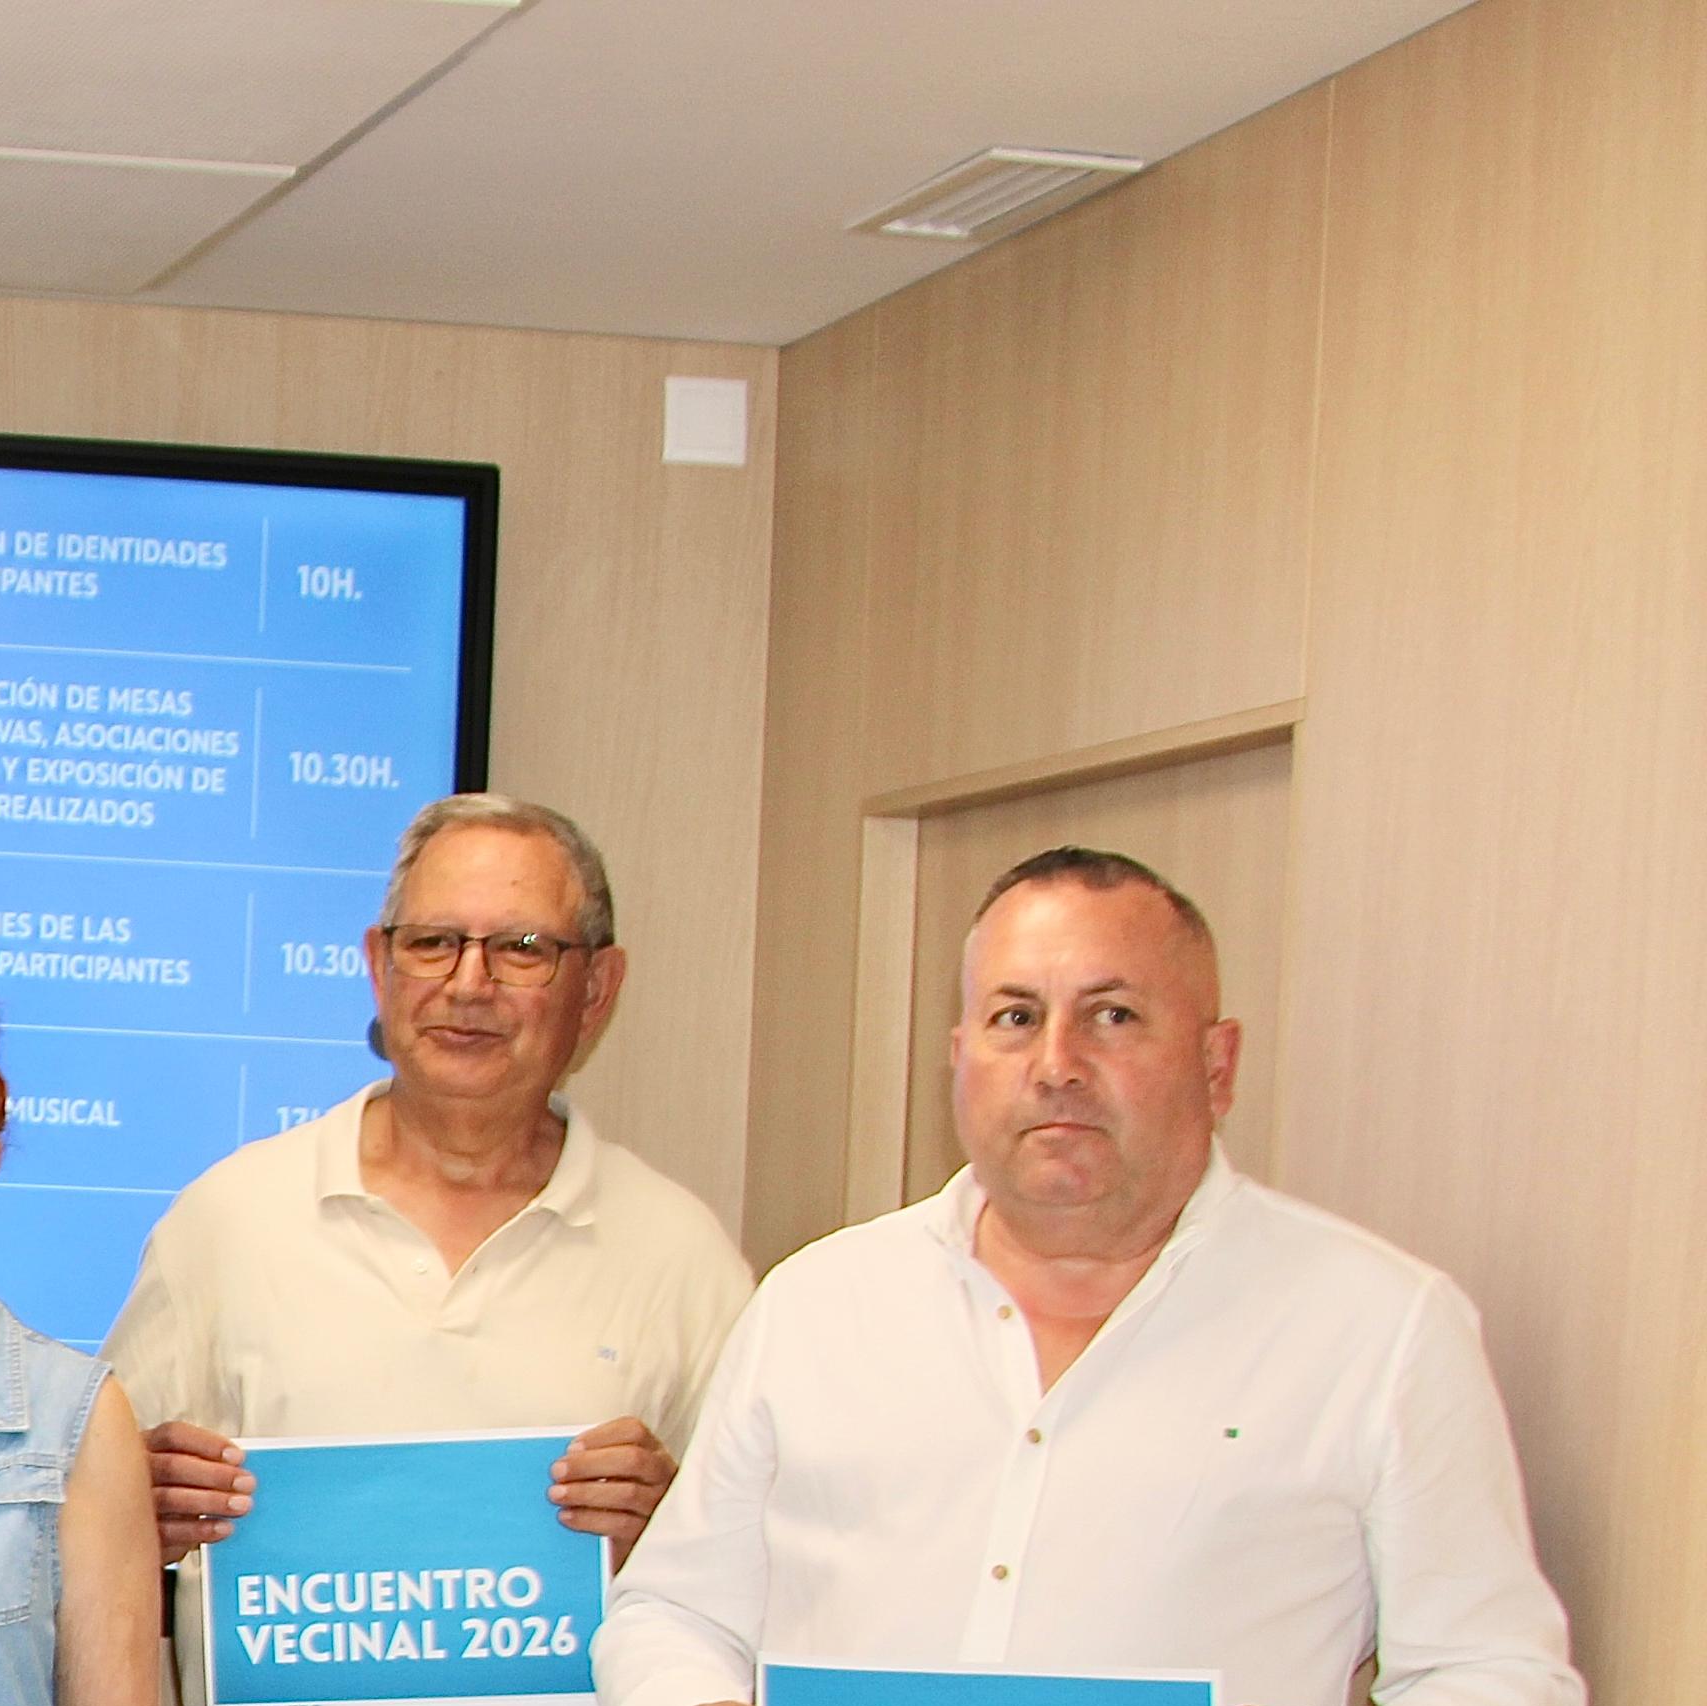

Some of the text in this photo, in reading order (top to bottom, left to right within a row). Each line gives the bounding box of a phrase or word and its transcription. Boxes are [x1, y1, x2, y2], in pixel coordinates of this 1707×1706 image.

[15, 531, 48, 558] DE
[57, 534, 227, 569] IDENTIDADES
[297, 565, 363, 600] 10H.
[66, 685, 100, 712] DE
[108, 687, 192, 717] MESAS
[54, 722, 239, 757] ASOCIACIONES
[2, 757, 20, 782] Y
[27, 758, 184, 790] EXPOSICIÓN
[192, 767, 226, 794] DE
[289, 751, 399, 788] 10.30H.
[40, 914, 75, 941] DE
[83, 916, 131, 944] LAS
[6, 1097, 121, 1127] MUSICAL
[239, 1566, 543, 1615] ENCUENTRO
[237, 1616, 579, 1664] VECINAL 2026
